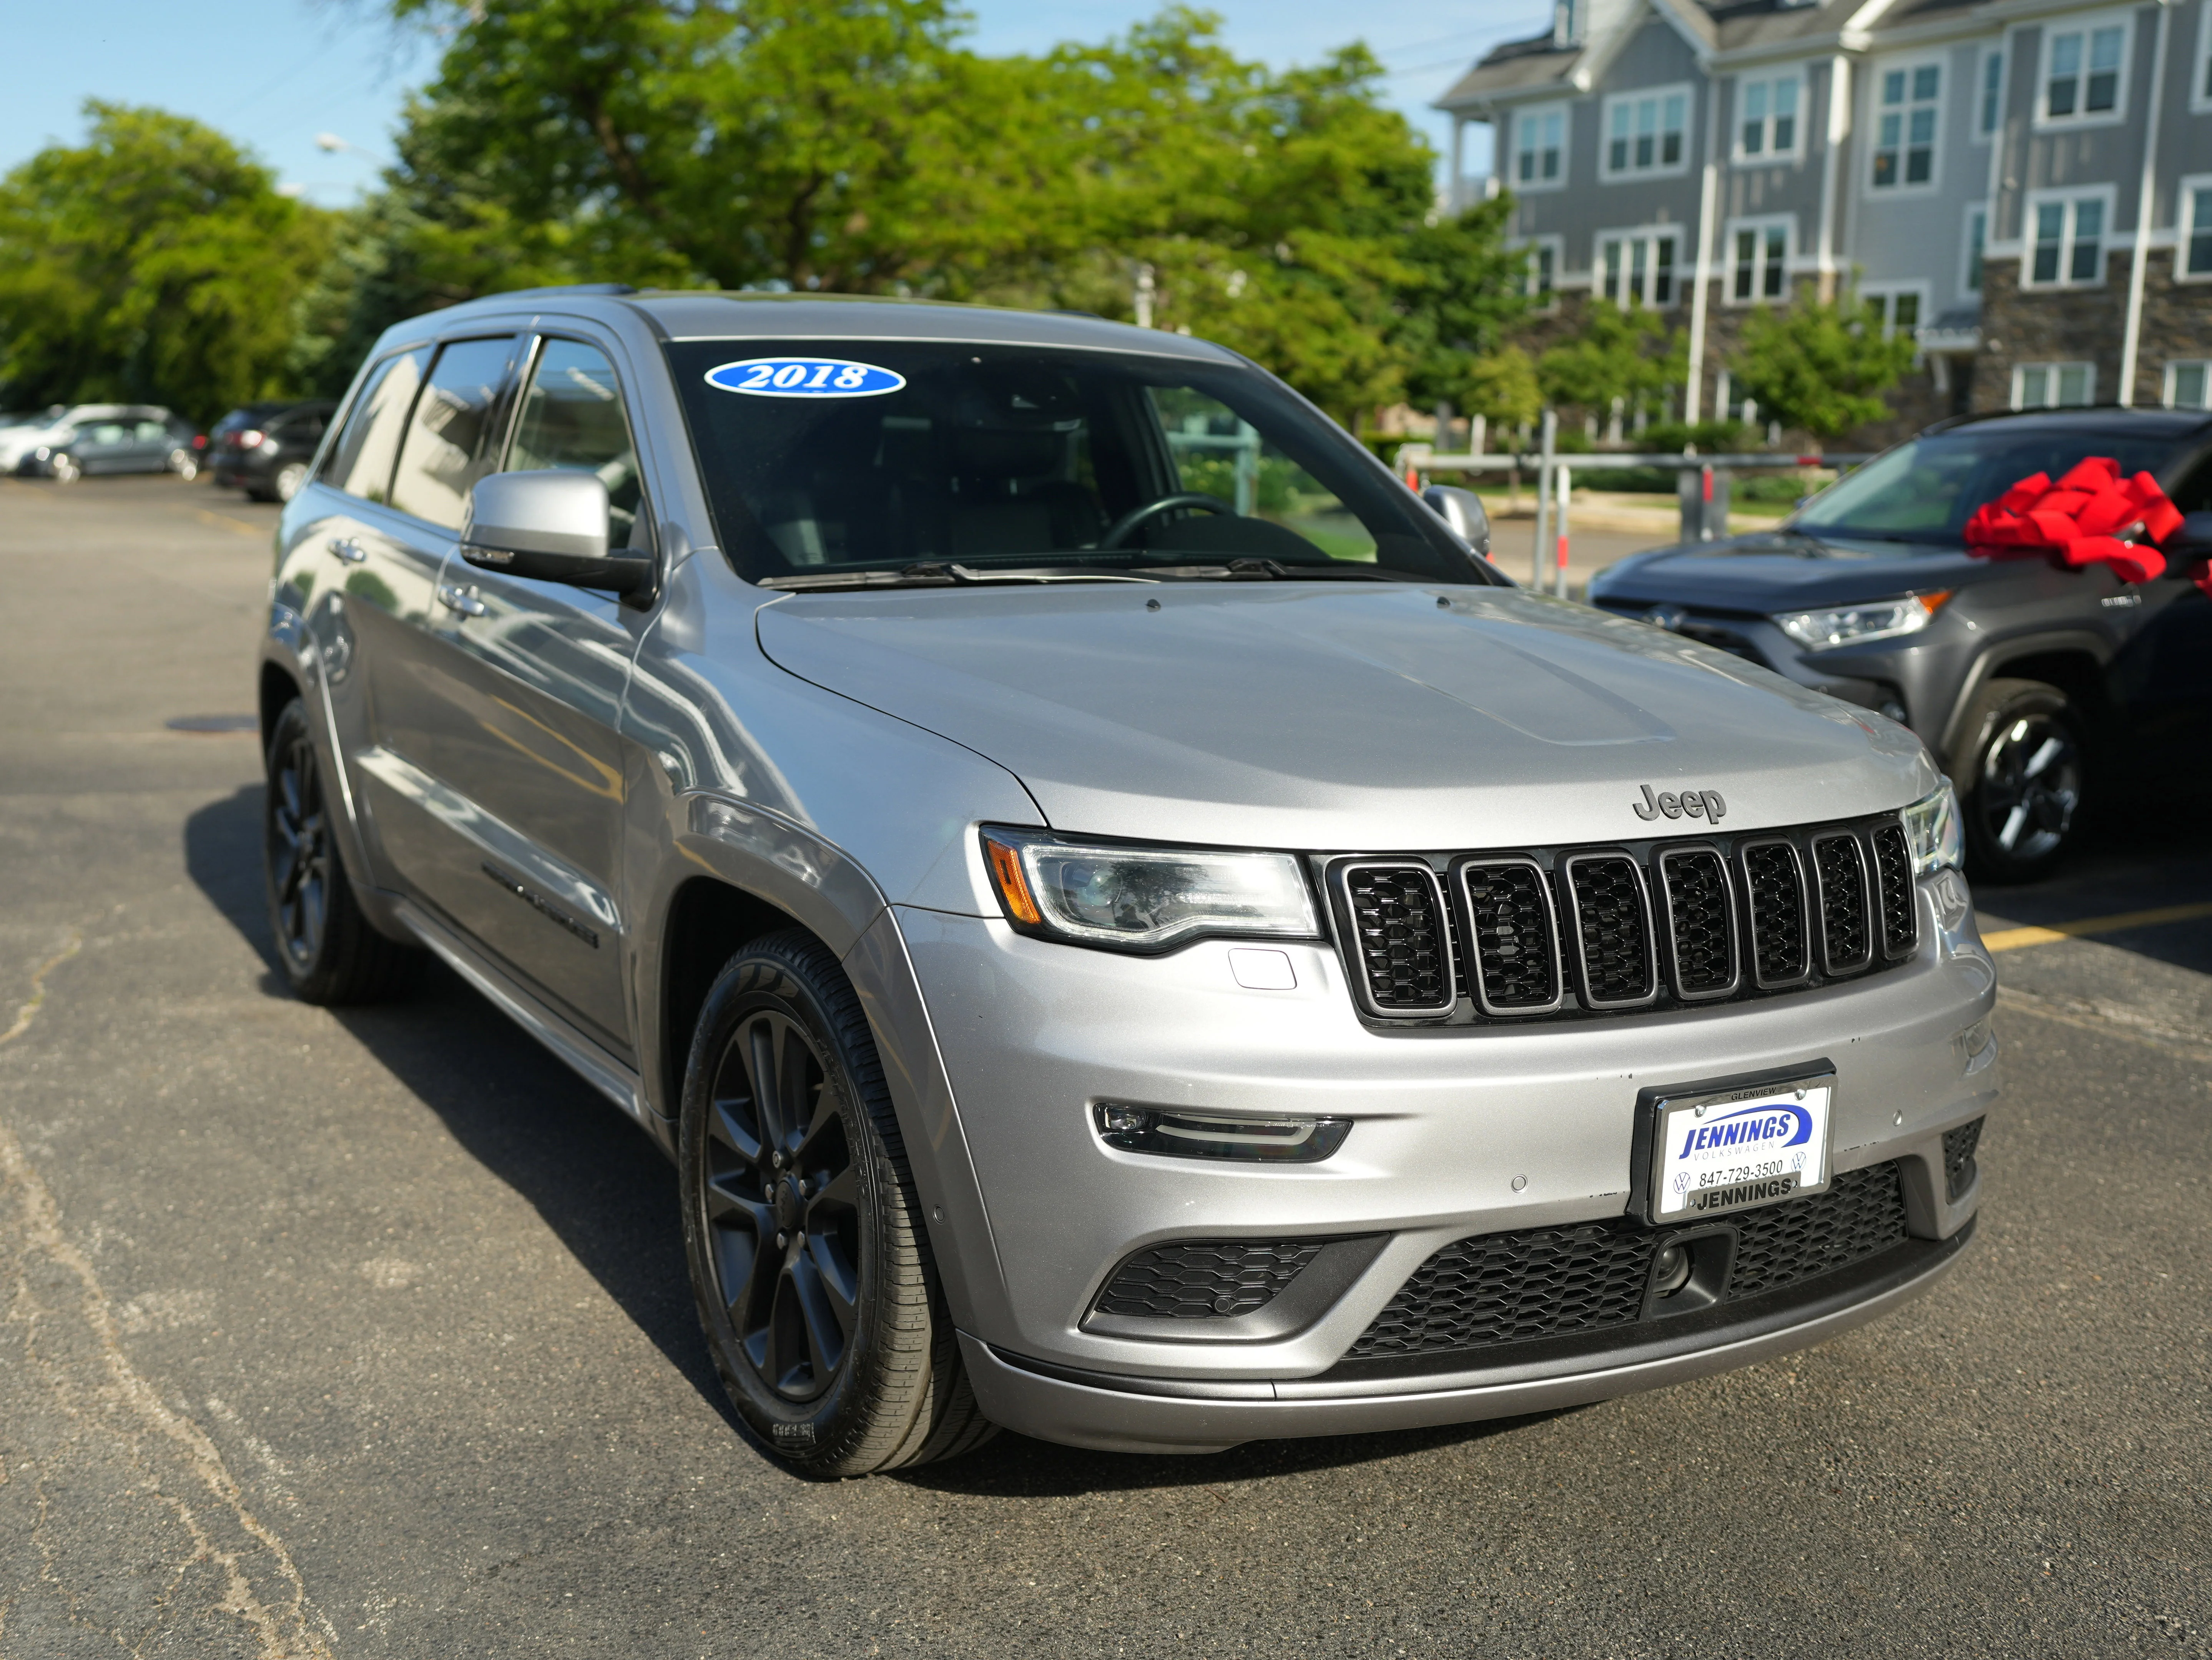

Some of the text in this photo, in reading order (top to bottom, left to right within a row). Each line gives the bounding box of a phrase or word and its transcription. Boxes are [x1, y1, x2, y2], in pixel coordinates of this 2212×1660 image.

[738, 365, 868, 388] 2018
[1632, 784, 1727, 825] Jeep
[1731, 1087, 1777, 1101] GLENVIEW
[1679, 1114, 1791, 1159] JENNINGS
[1694, 1141, 1774, 1161] VOLKSWAGEN
[1699, 1159, 1783, 1187] 847-729-3500
[1697, 1178, 1792, 1210] JENNINGS
